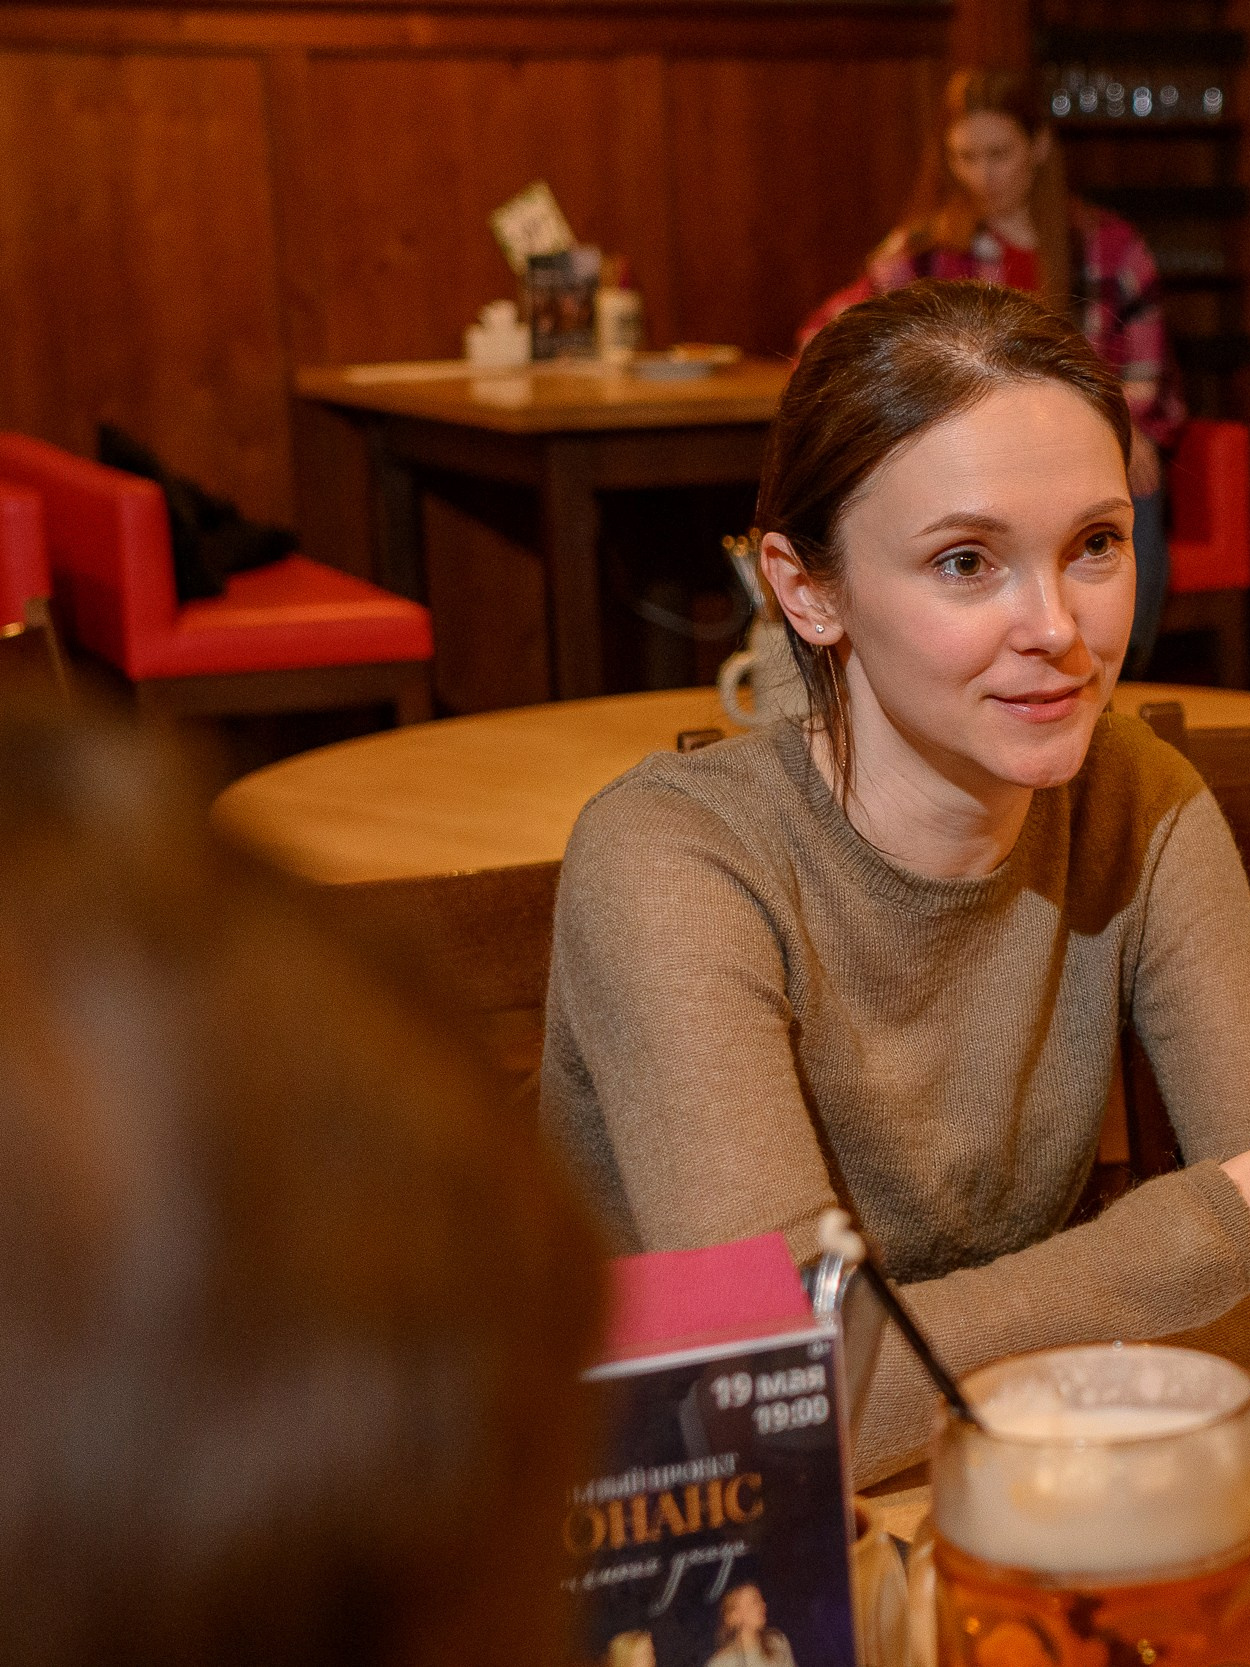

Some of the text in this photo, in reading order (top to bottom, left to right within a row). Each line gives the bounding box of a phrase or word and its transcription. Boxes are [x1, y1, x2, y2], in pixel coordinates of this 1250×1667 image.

[711, 1363, 827, 1411] 19 мая
[751, 1393, 830, 1435] 19:00
[564, 1472, 765, 1553] ОНАНС
